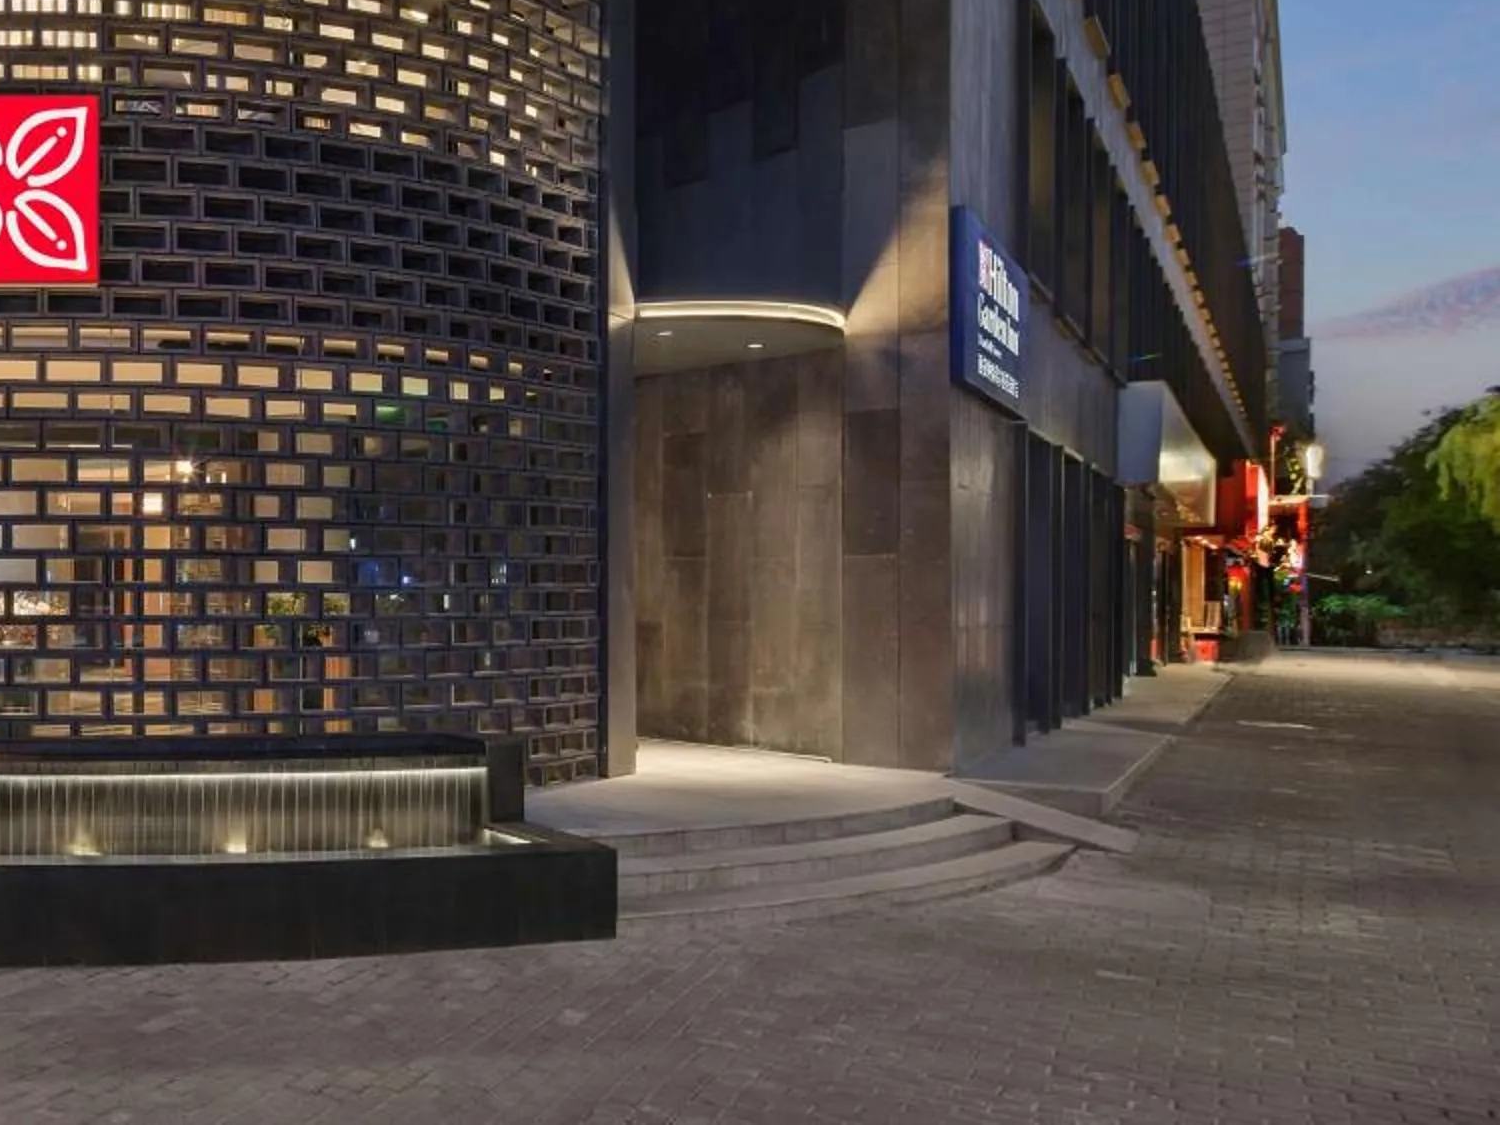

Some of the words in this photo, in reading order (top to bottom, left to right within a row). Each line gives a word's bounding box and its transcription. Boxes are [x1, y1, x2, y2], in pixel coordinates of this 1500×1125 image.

[990, 249, 1019, 322] Hilton
[978, 292, 1007, 345] Garden
[1007, 316, 1019, 356] Inn
